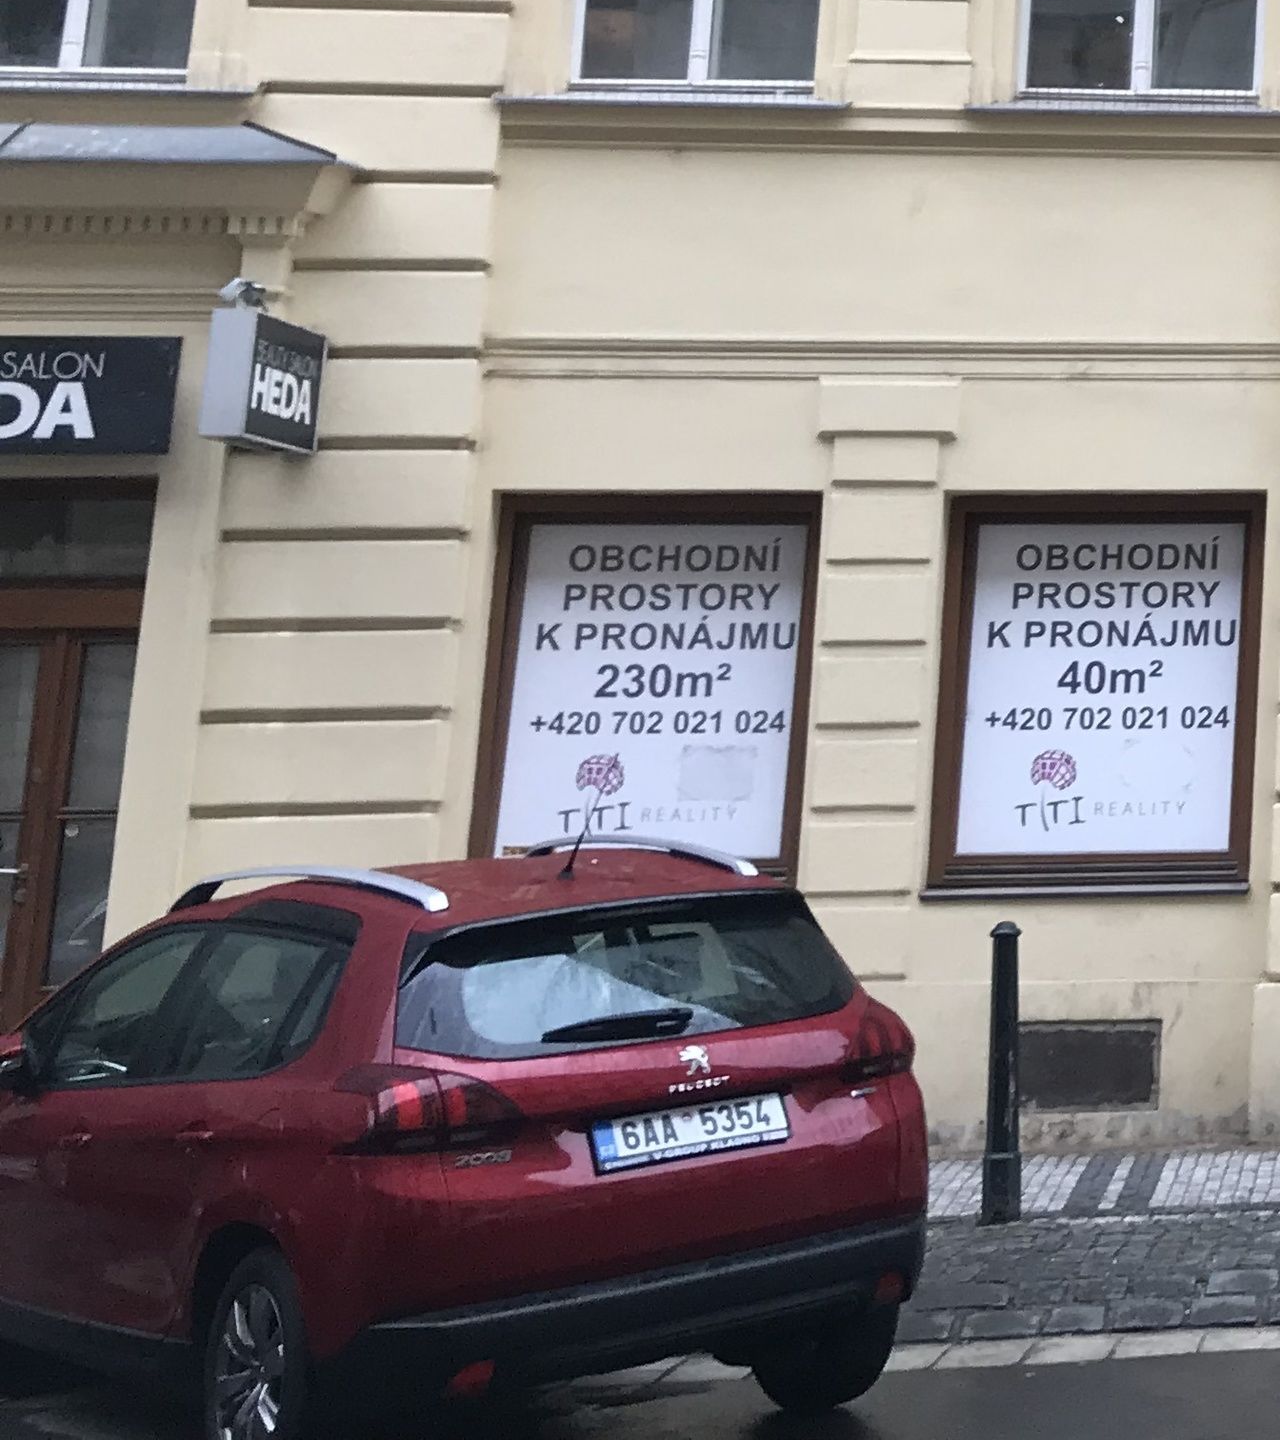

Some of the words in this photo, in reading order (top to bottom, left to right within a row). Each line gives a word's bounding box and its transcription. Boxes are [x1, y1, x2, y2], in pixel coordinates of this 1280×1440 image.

[1, 351, 106, 379] SALON
[251, 363, 311, 425] HEDA
[568, 537, 782, 573] OBCHODNÍ
[1016, 536, 1221, 571] OBCHODNÍ
[563, 582, 781, 612] PROSTORY
[1012, 581, 1221, 610] PROSTORY
[535, 623, 563, 651] K
[574, 616, 797, 651] PRONÁJMU
[986, 621, 1012, 648] K
[1024, 613, 1237, 648] PRONÁJMU
[530, 711, 601, 735] +420
[612, 711, 664, 735] 702
[673, 711, 722, 734] 021
[735, 710, 786, 734] 024
[985, 707, 1052, 731] +420
[1062, 707, 1112, 730] 702
[1122, 706, 1169, 729] 021
[1181, 706, 1230, 729] 024
[1094, 801, 1187, 818] REALITY
[668, 1076, 730, 1093] PEUGEOT
[620, 1114, 680, 1150] 6AA
[698, 1100, 771, 1136] 5354
